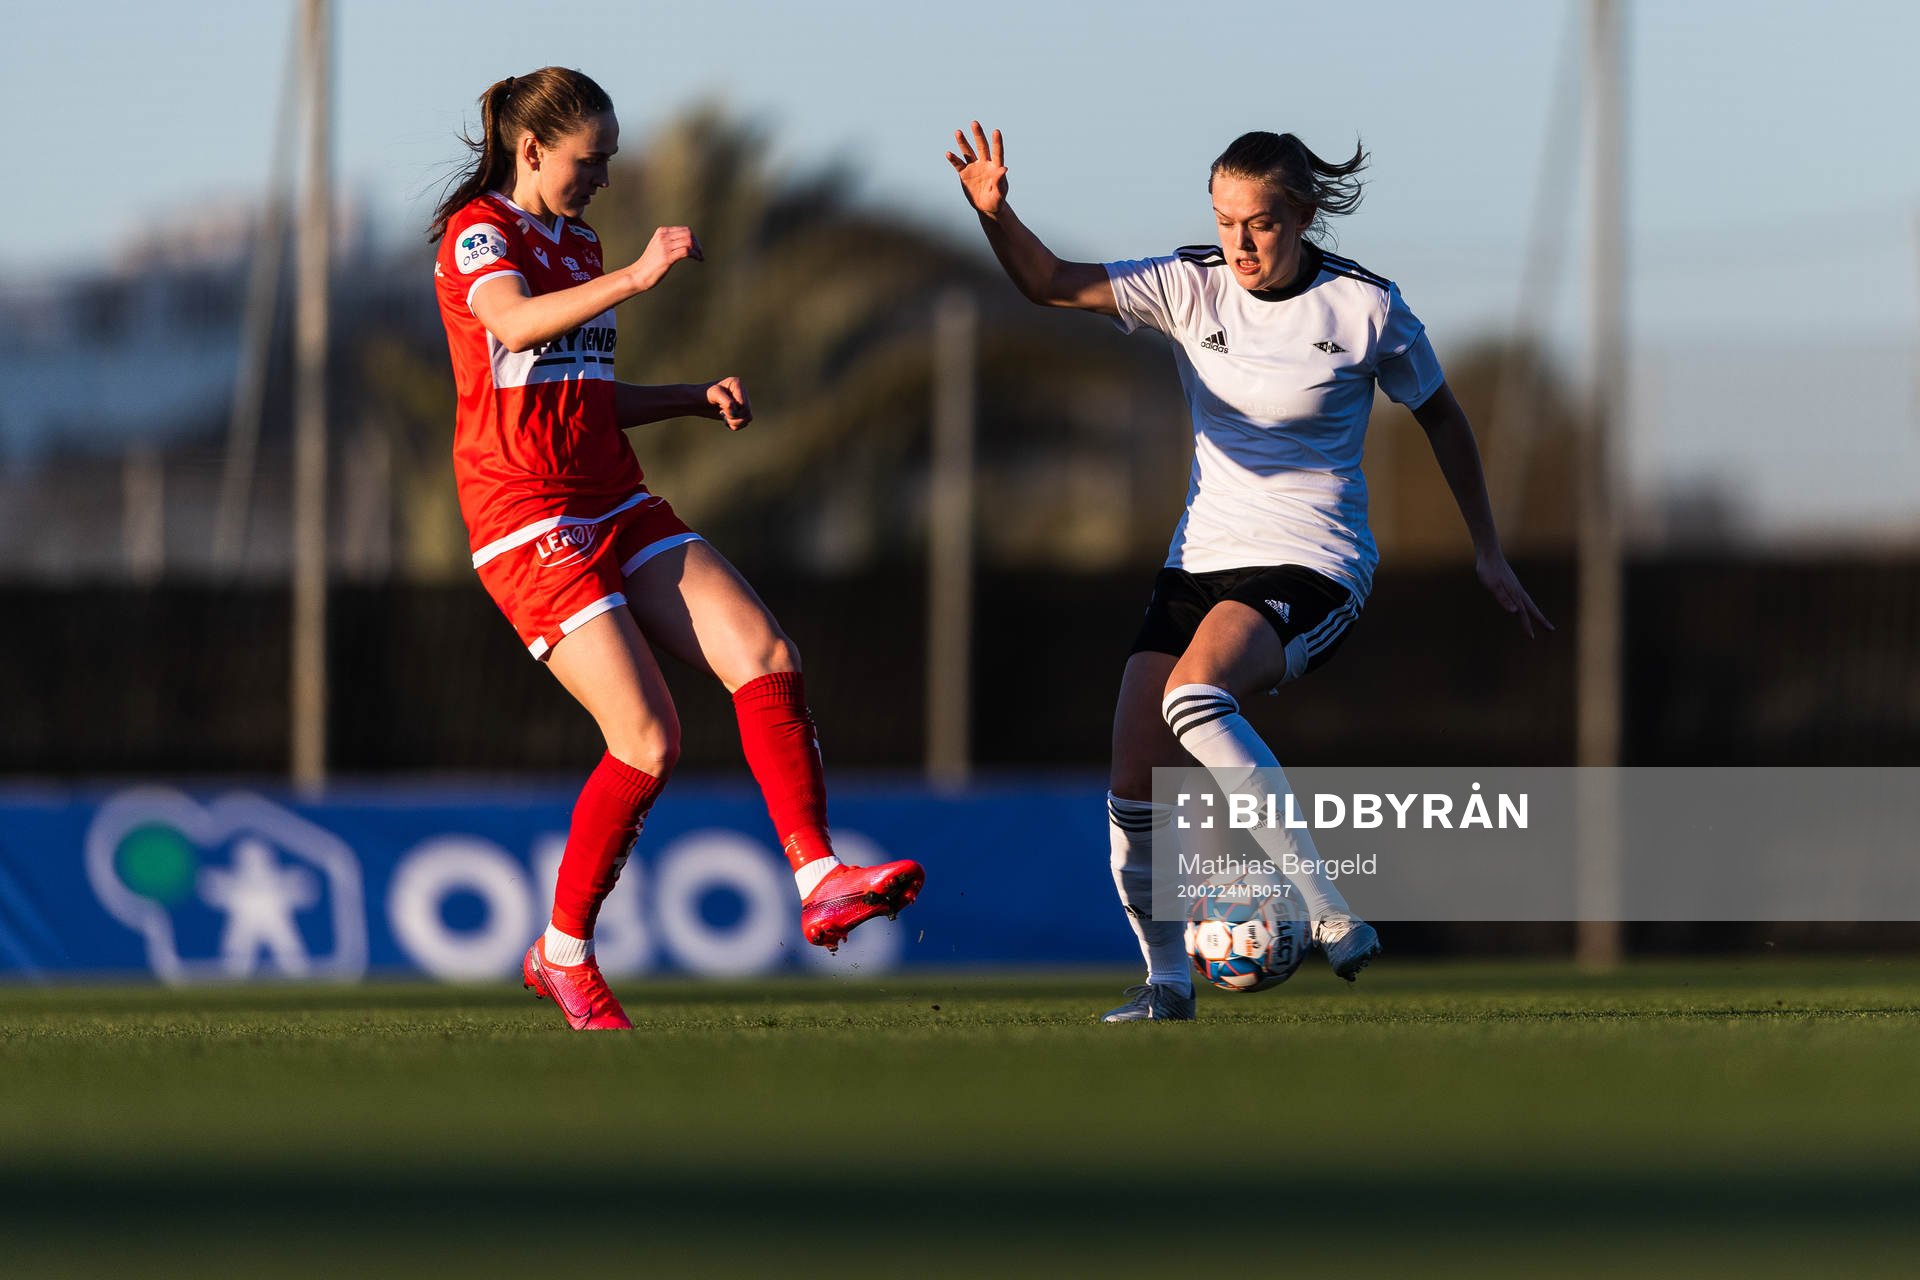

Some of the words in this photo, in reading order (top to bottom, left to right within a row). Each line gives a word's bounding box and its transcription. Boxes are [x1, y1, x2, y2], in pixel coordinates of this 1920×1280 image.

[463, 244, 499, 266] OBOS
[1200, 341, 1229, 354] adidas
[535, 524, 597, 559] LERØY
[1264, 599, 1290, 624] adidas
